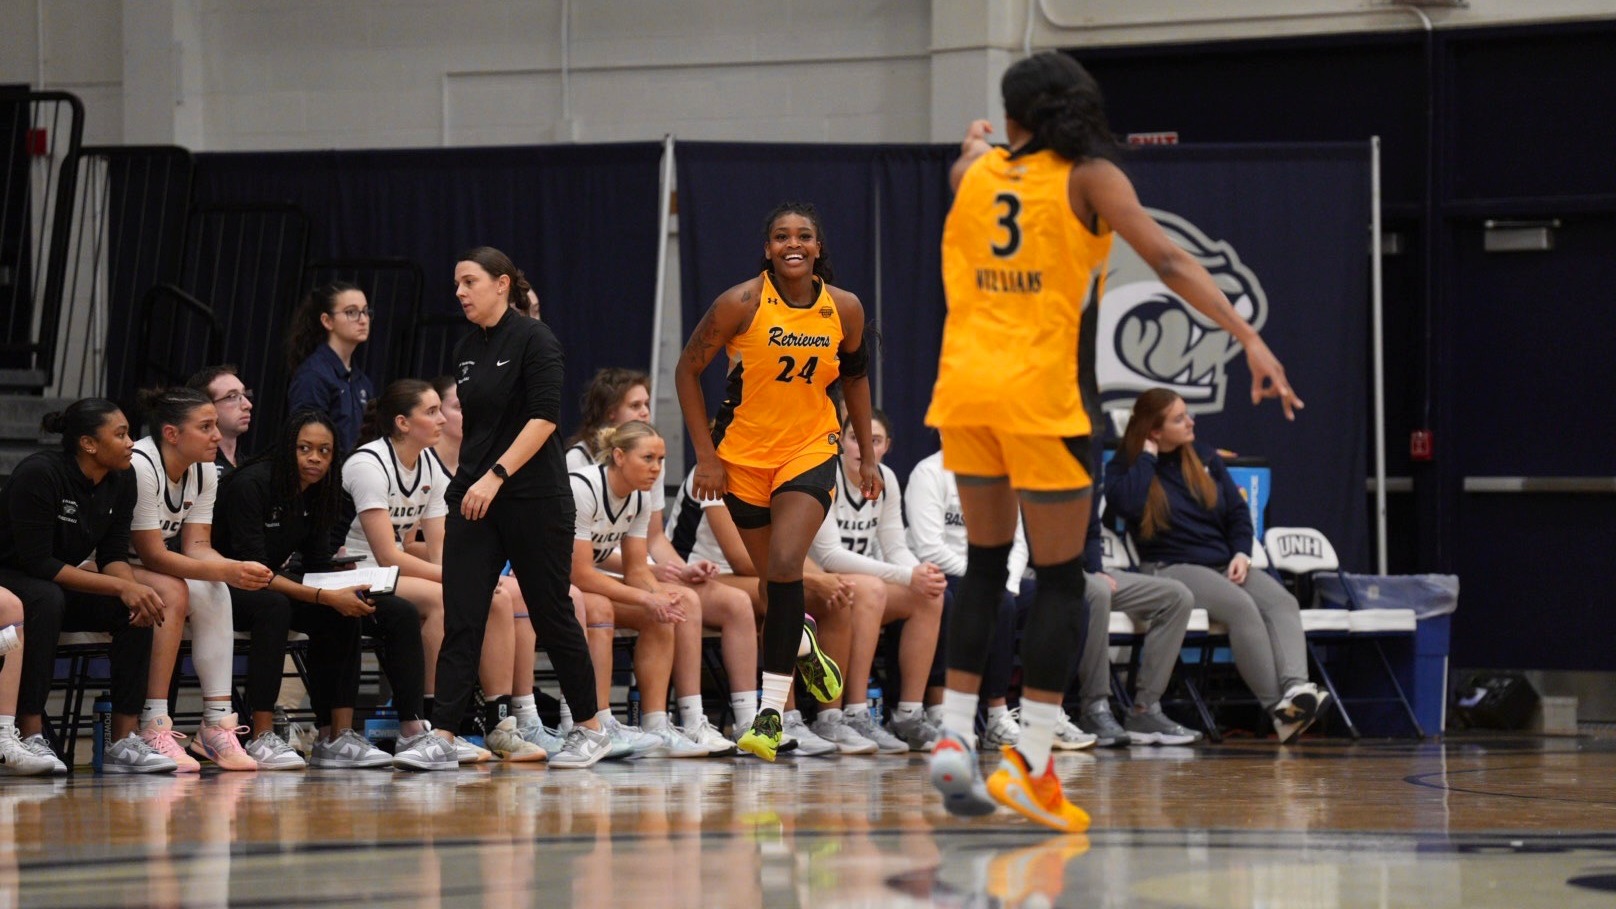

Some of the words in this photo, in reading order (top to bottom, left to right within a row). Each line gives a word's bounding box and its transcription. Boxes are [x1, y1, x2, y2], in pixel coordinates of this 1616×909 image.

[991, 192, 1022, 258] 3
[768, 326, 831, 348] Retrievers
[775, 355, 819, 385] 24
[1277, 534, 1323, 559] UNH
